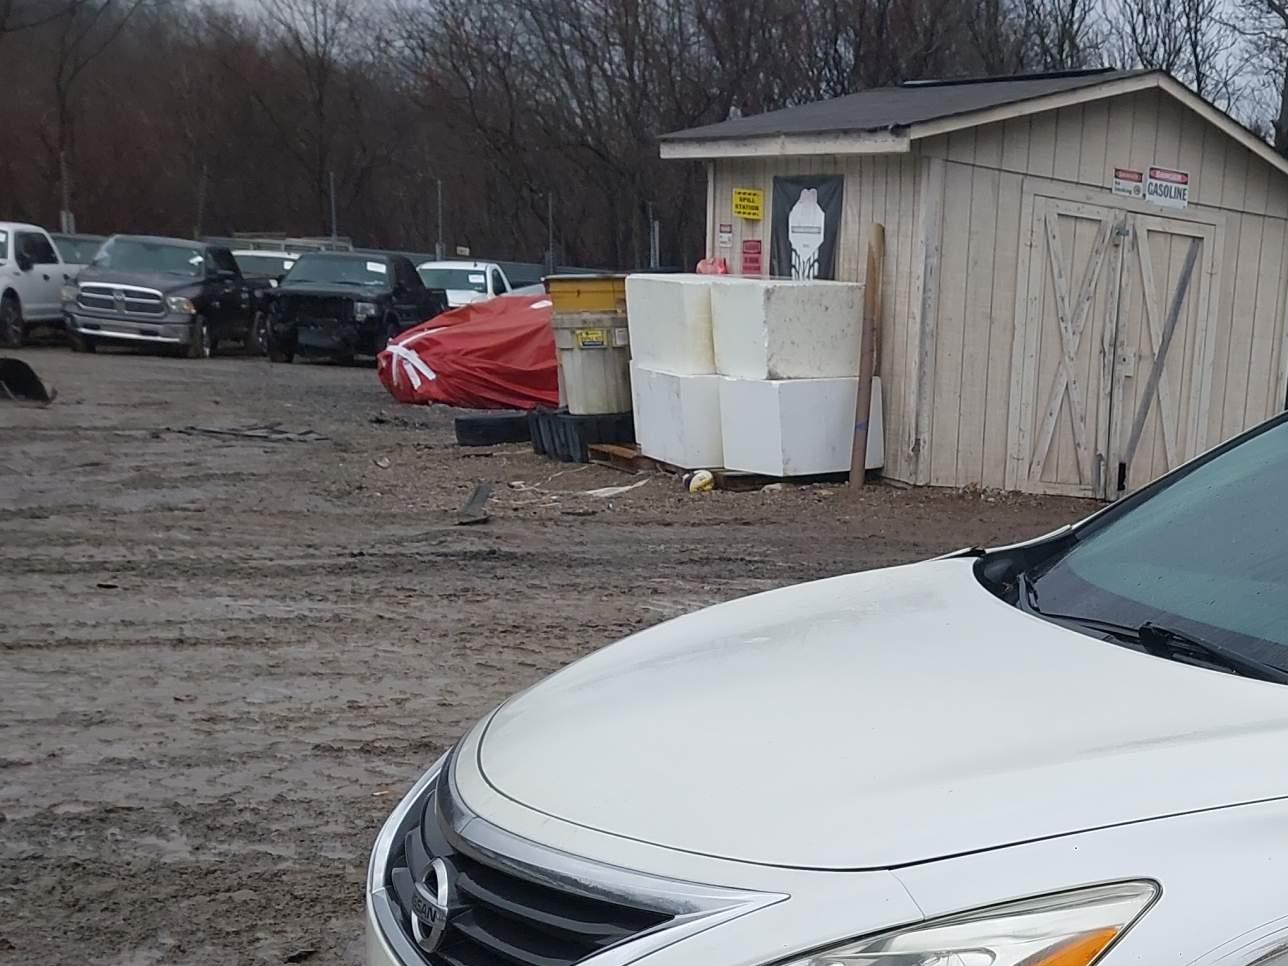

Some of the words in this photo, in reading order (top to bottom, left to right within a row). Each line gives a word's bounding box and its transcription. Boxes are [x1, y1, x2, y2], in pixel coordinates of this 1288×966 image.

[1147, 182, 1188, 201] GASOLINE
[739, 196, 755, 204] SPILL
[735, 203, 759, 211] STATION
